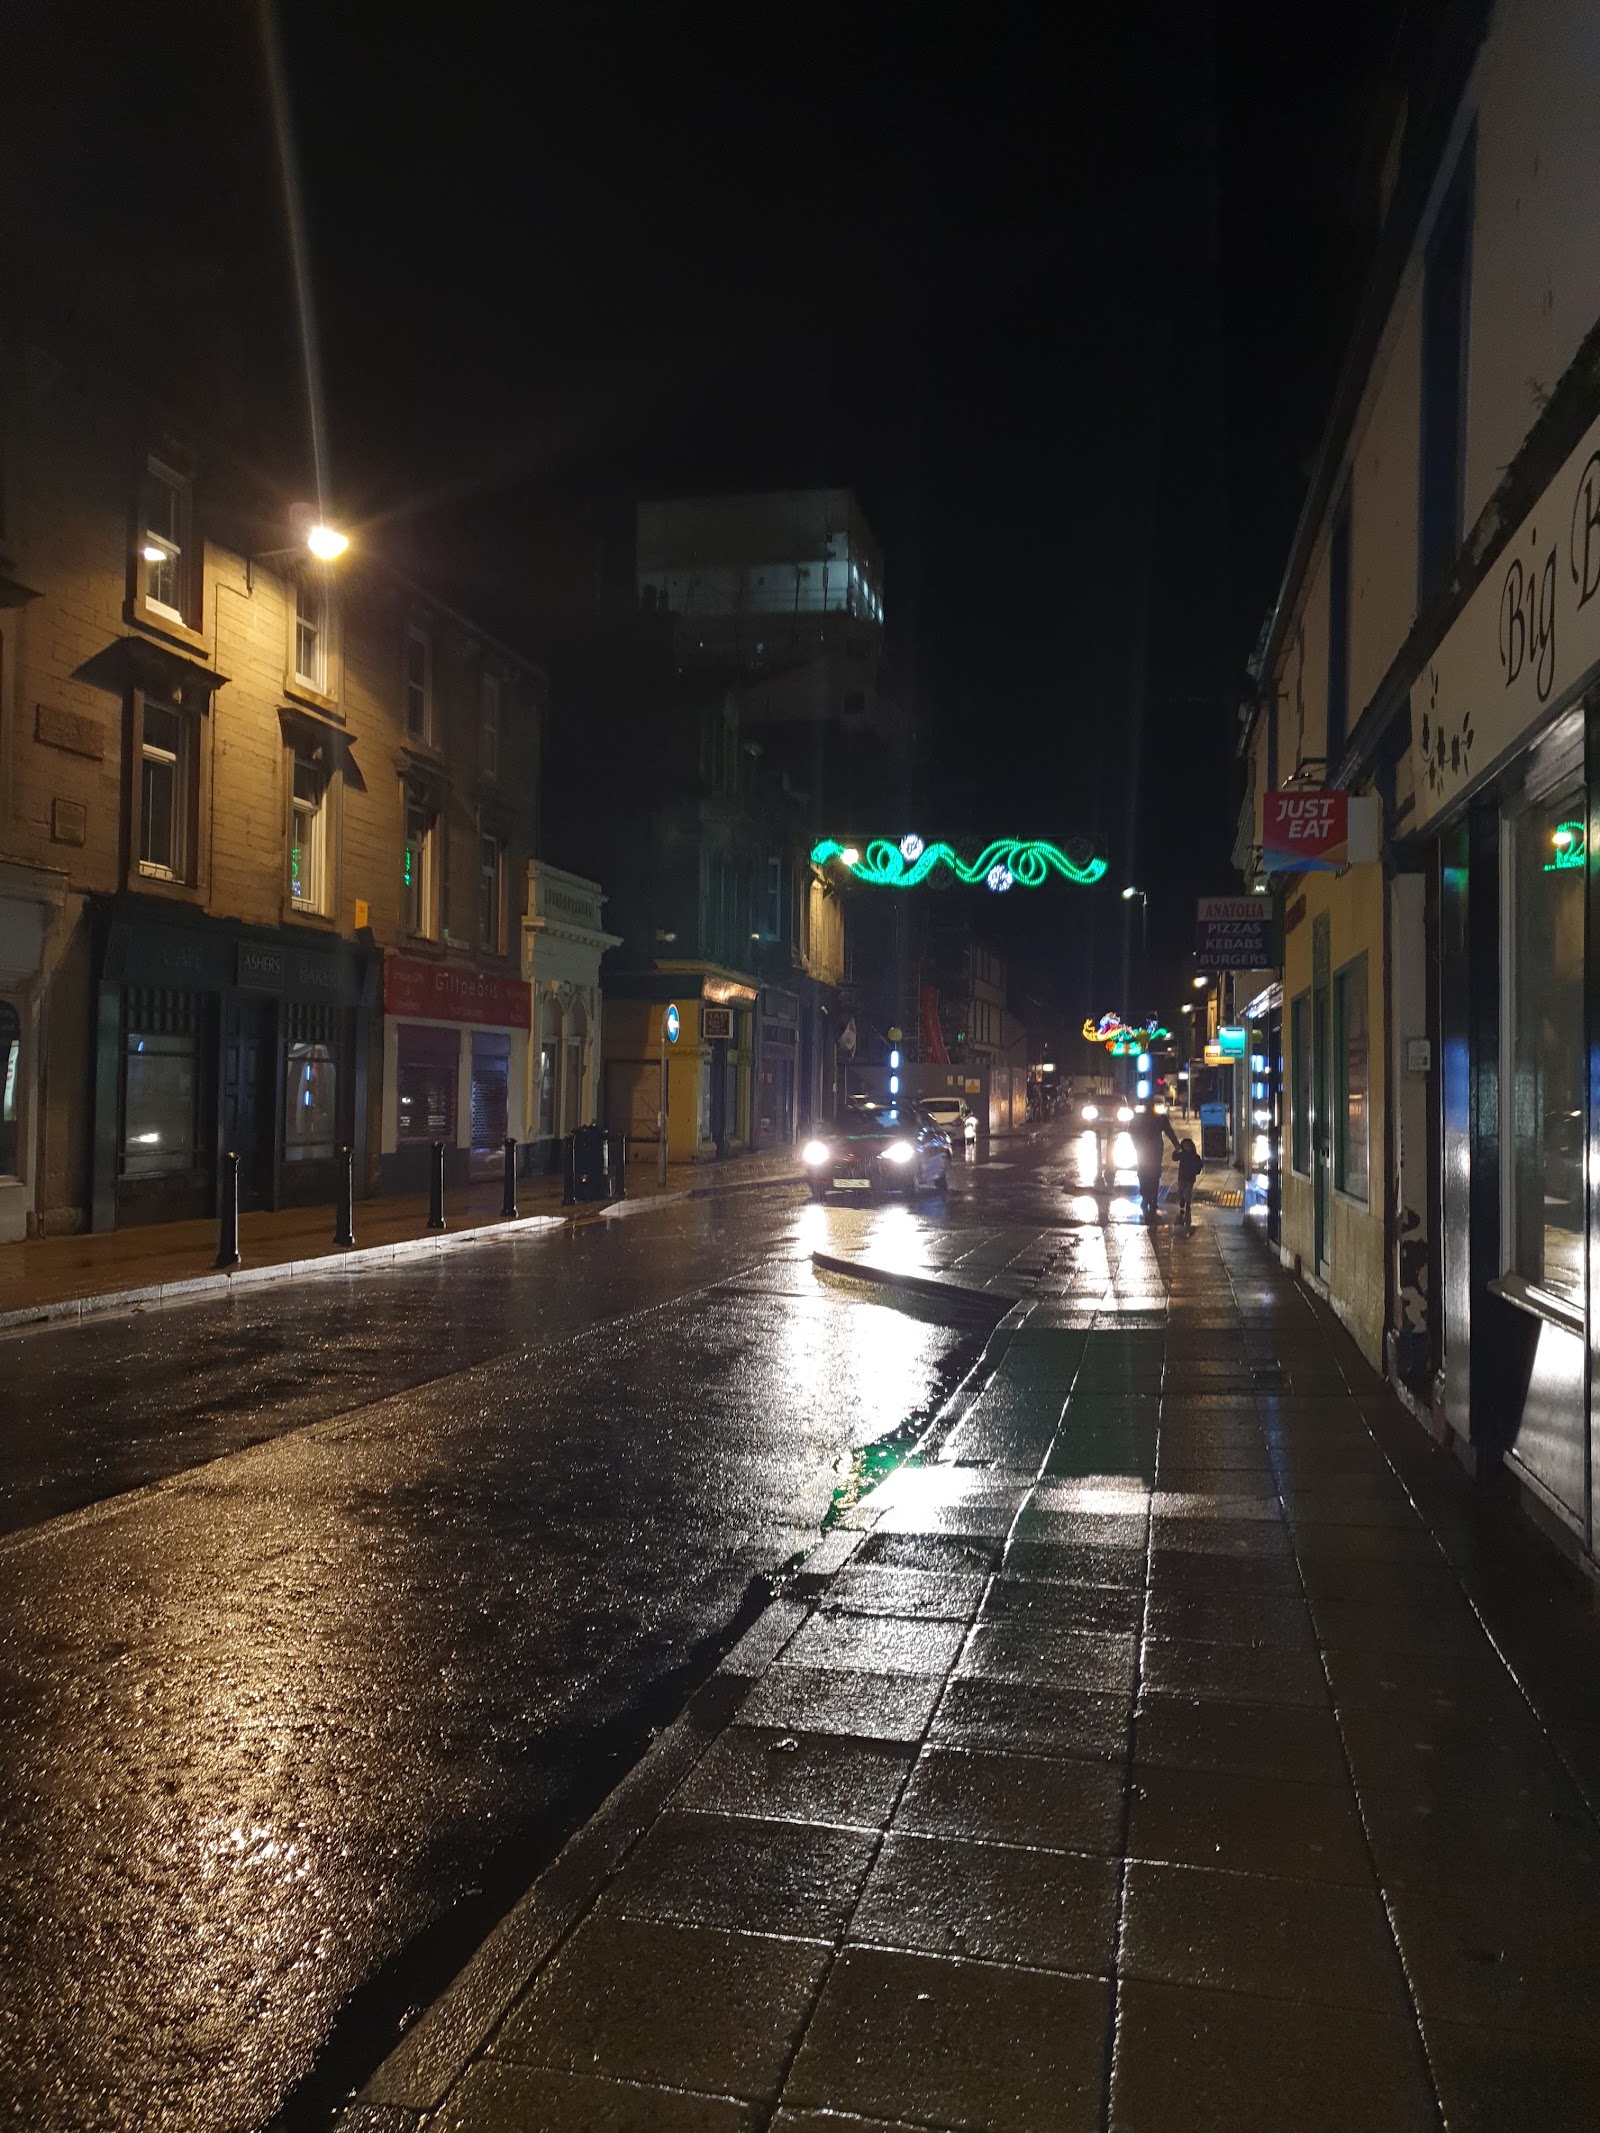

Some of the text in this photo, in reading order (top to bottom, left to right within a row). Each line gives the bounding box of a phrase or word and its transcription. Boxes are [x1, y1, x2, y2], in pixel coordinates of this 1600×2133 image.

[1499, 527, 1557, 703] Big
[1276, 798, 1335, 822] JUST
[1288, 818, 1336, 839] EAT
[1205, 903, 1264, 918] ANATOLIA
[1208, 922, 1261, 934] PIZZAS
[1205, 938, 1263, 950] KEBABS
[243, 954, 281, 974] ASHERS
[1200, 954, 1267, 966] BURGERS
